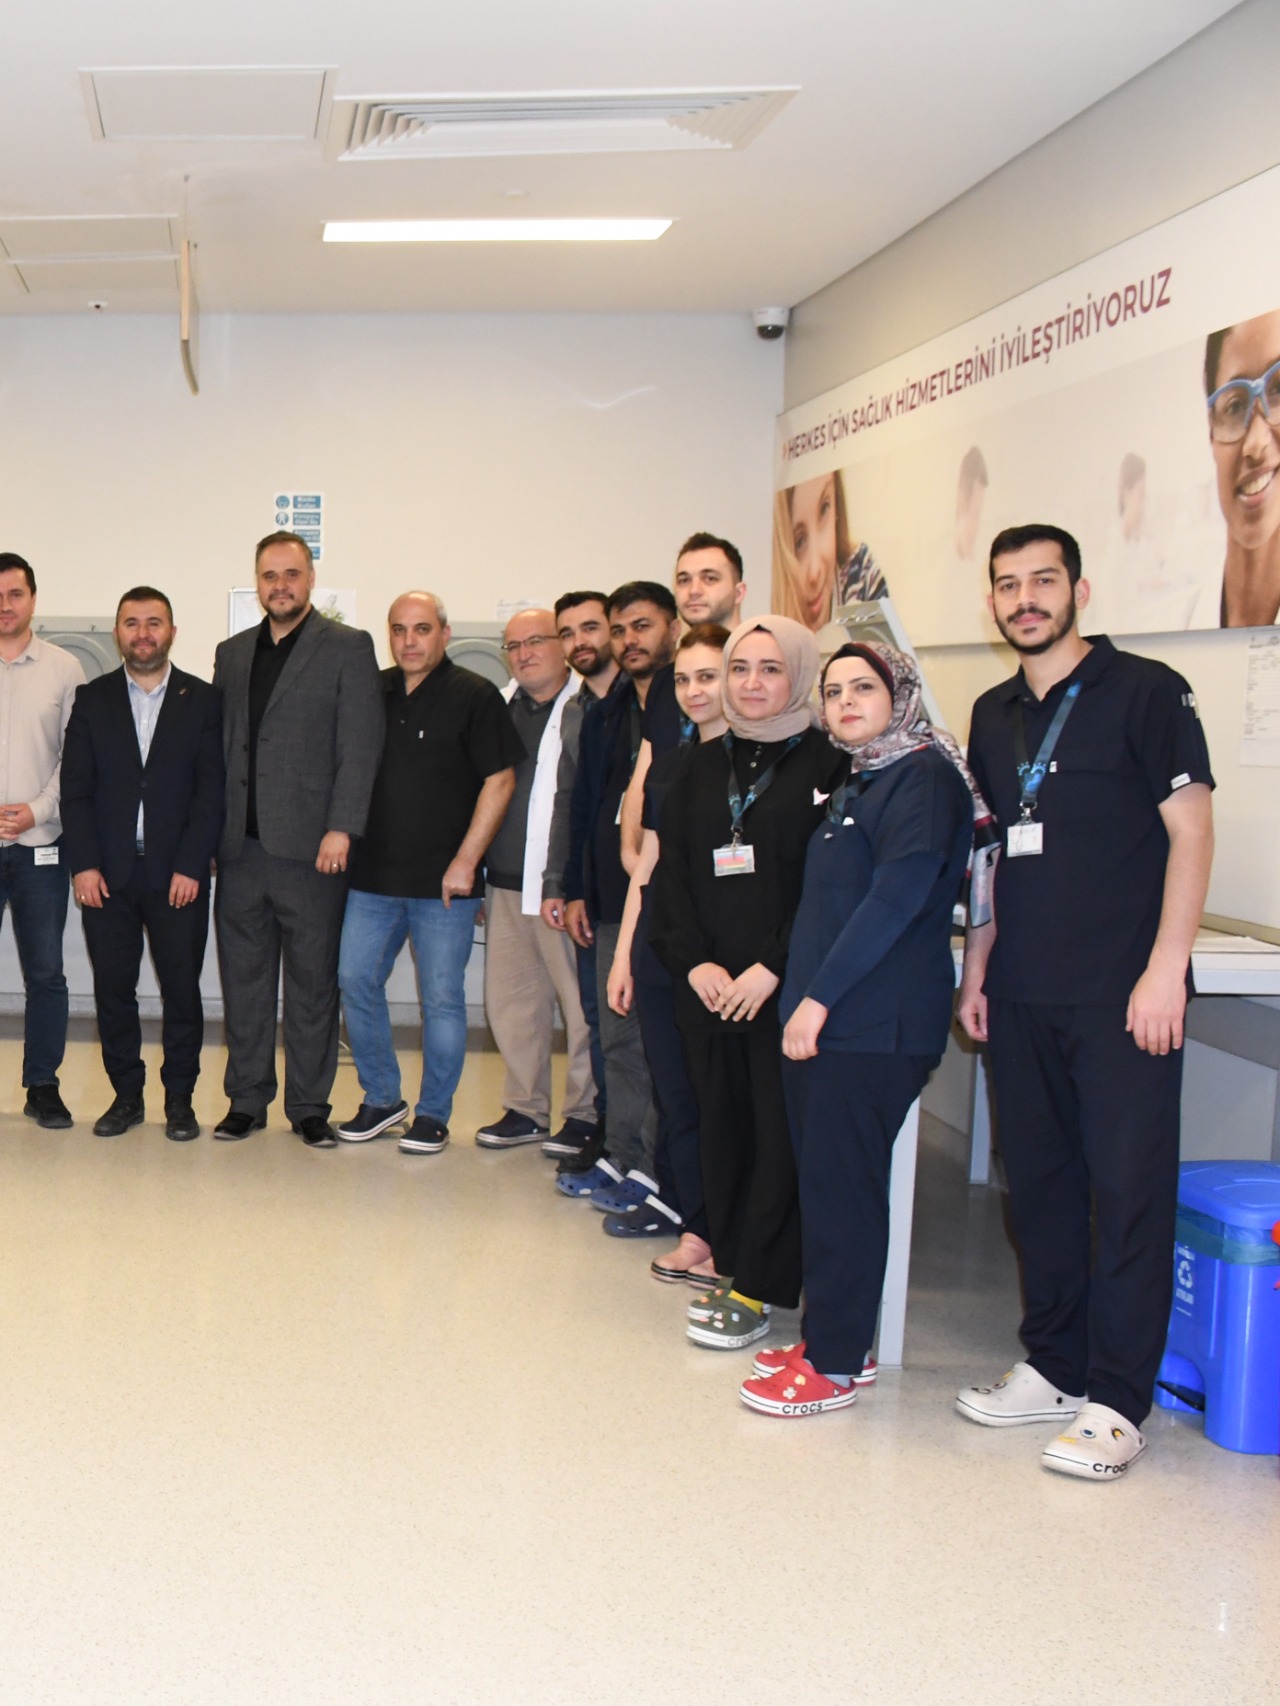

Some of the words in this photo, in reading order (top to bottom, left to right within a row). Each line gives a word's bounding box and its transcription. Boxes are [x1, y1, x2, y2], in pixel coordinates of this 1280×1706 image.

[788, 424, 826, 460] HERKES
[828, 409, 849, 450] İÇİN
[851, 394, 893, 433] SAĞLIK
[895, 337, 996, 416] HİZMETLERİNİ
[999, 267, 1172, 373] İYİLEŞTİRİYORUZ
[782, 1402, 823, 1414] crocs
